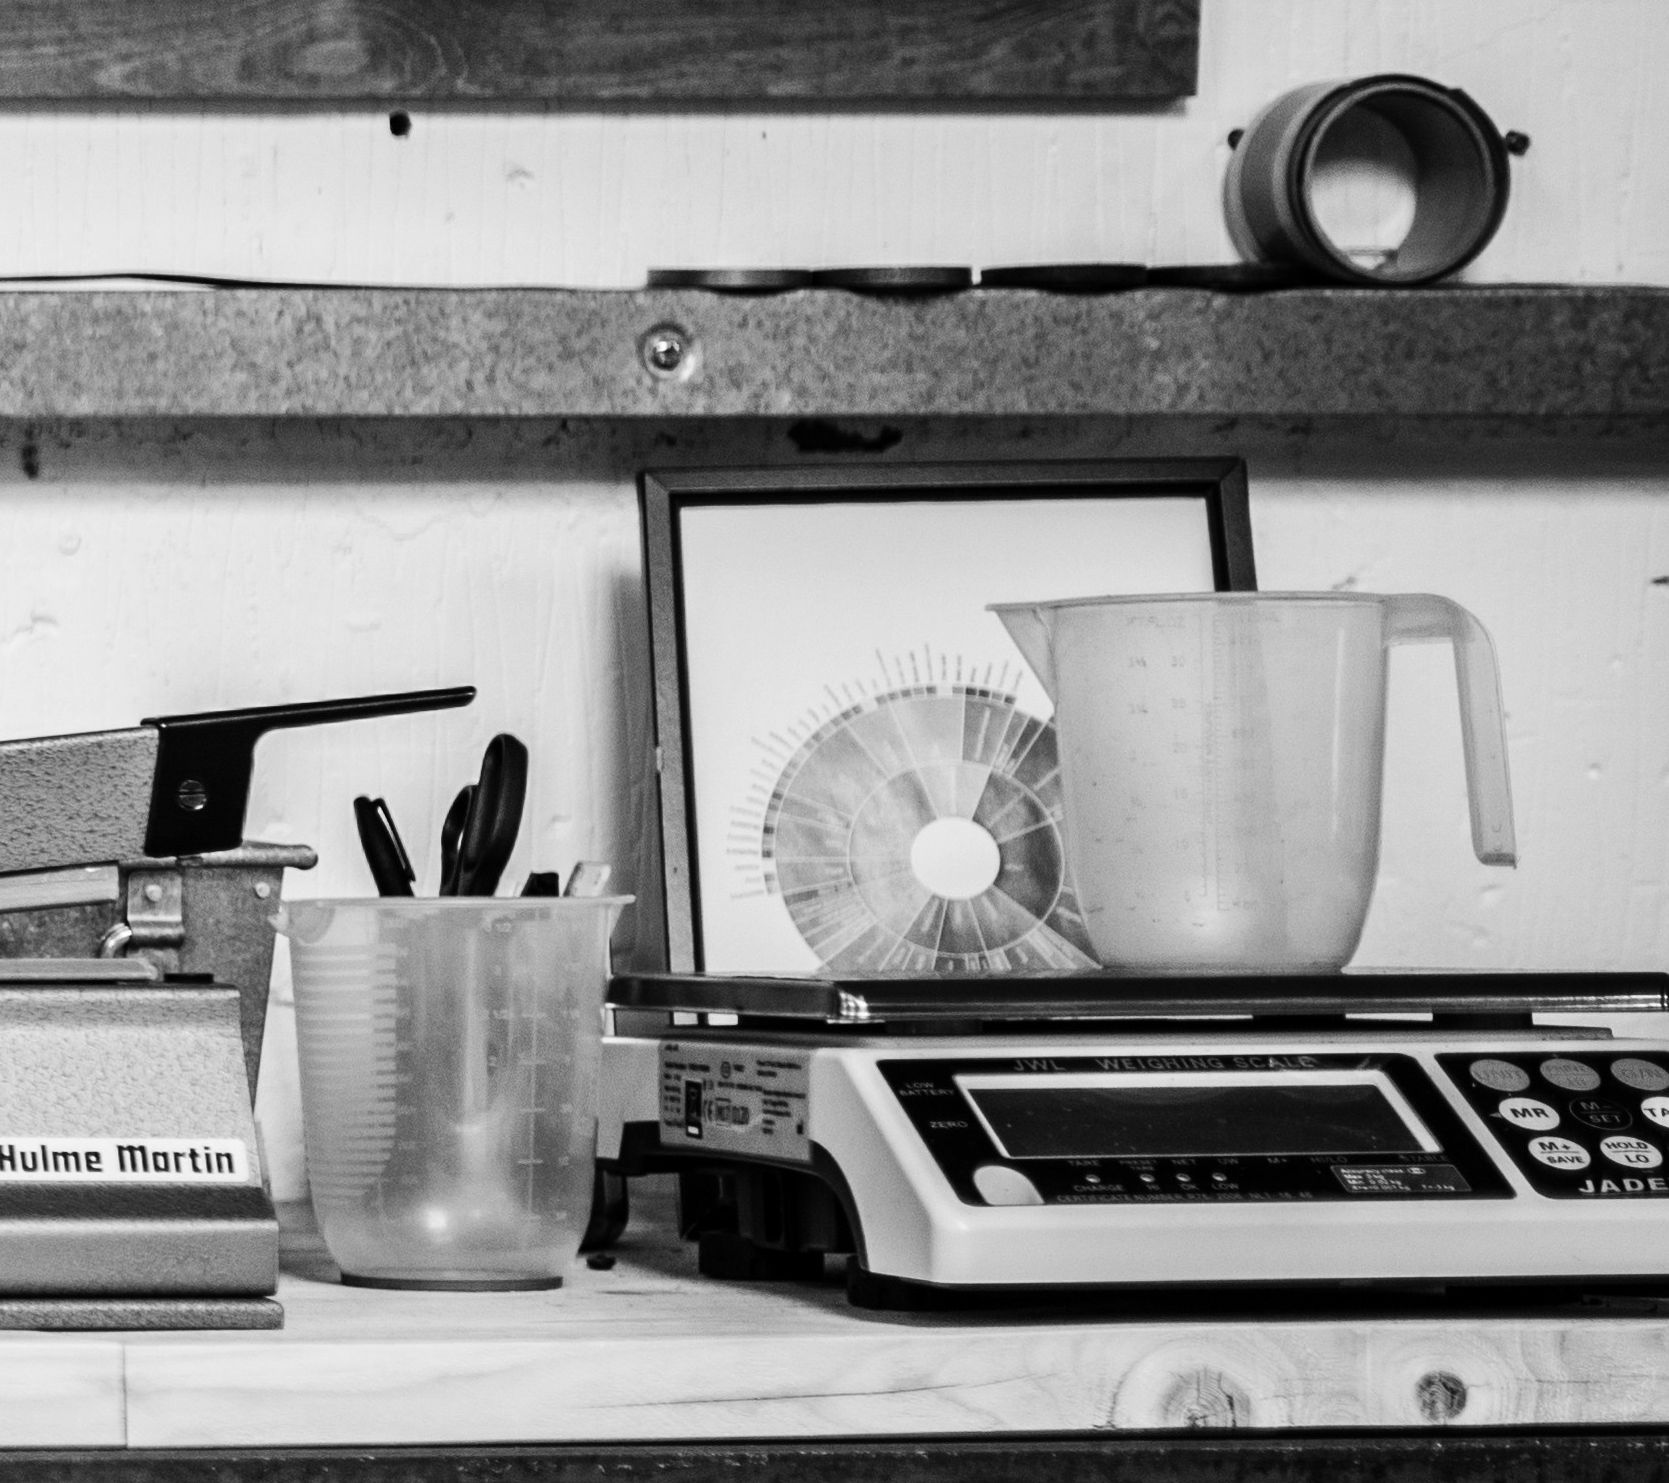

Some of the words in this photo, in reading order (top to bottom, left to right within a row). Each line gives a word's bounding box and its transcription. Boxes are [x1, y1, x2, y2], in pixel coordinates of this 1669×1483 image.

[1013, 1059, 1067, 1072] JWL
[1094, 1057, 1224, 1072] WEIGHING
[1233, 1054, 1319, 1069] SCALE
[1510, 1107, 1550, 1119] MR
[930, 1120, 969, 1129] ZERO
[1589, 1115, 1622, 1124] SET
[1604, 1141, 1649, 1151] HOLD
[116, 1144, 235, 1174] Martin
[1546, 1155, 1586, 1165] SAVE
[1625, 1154, 1650, 1164] LO
